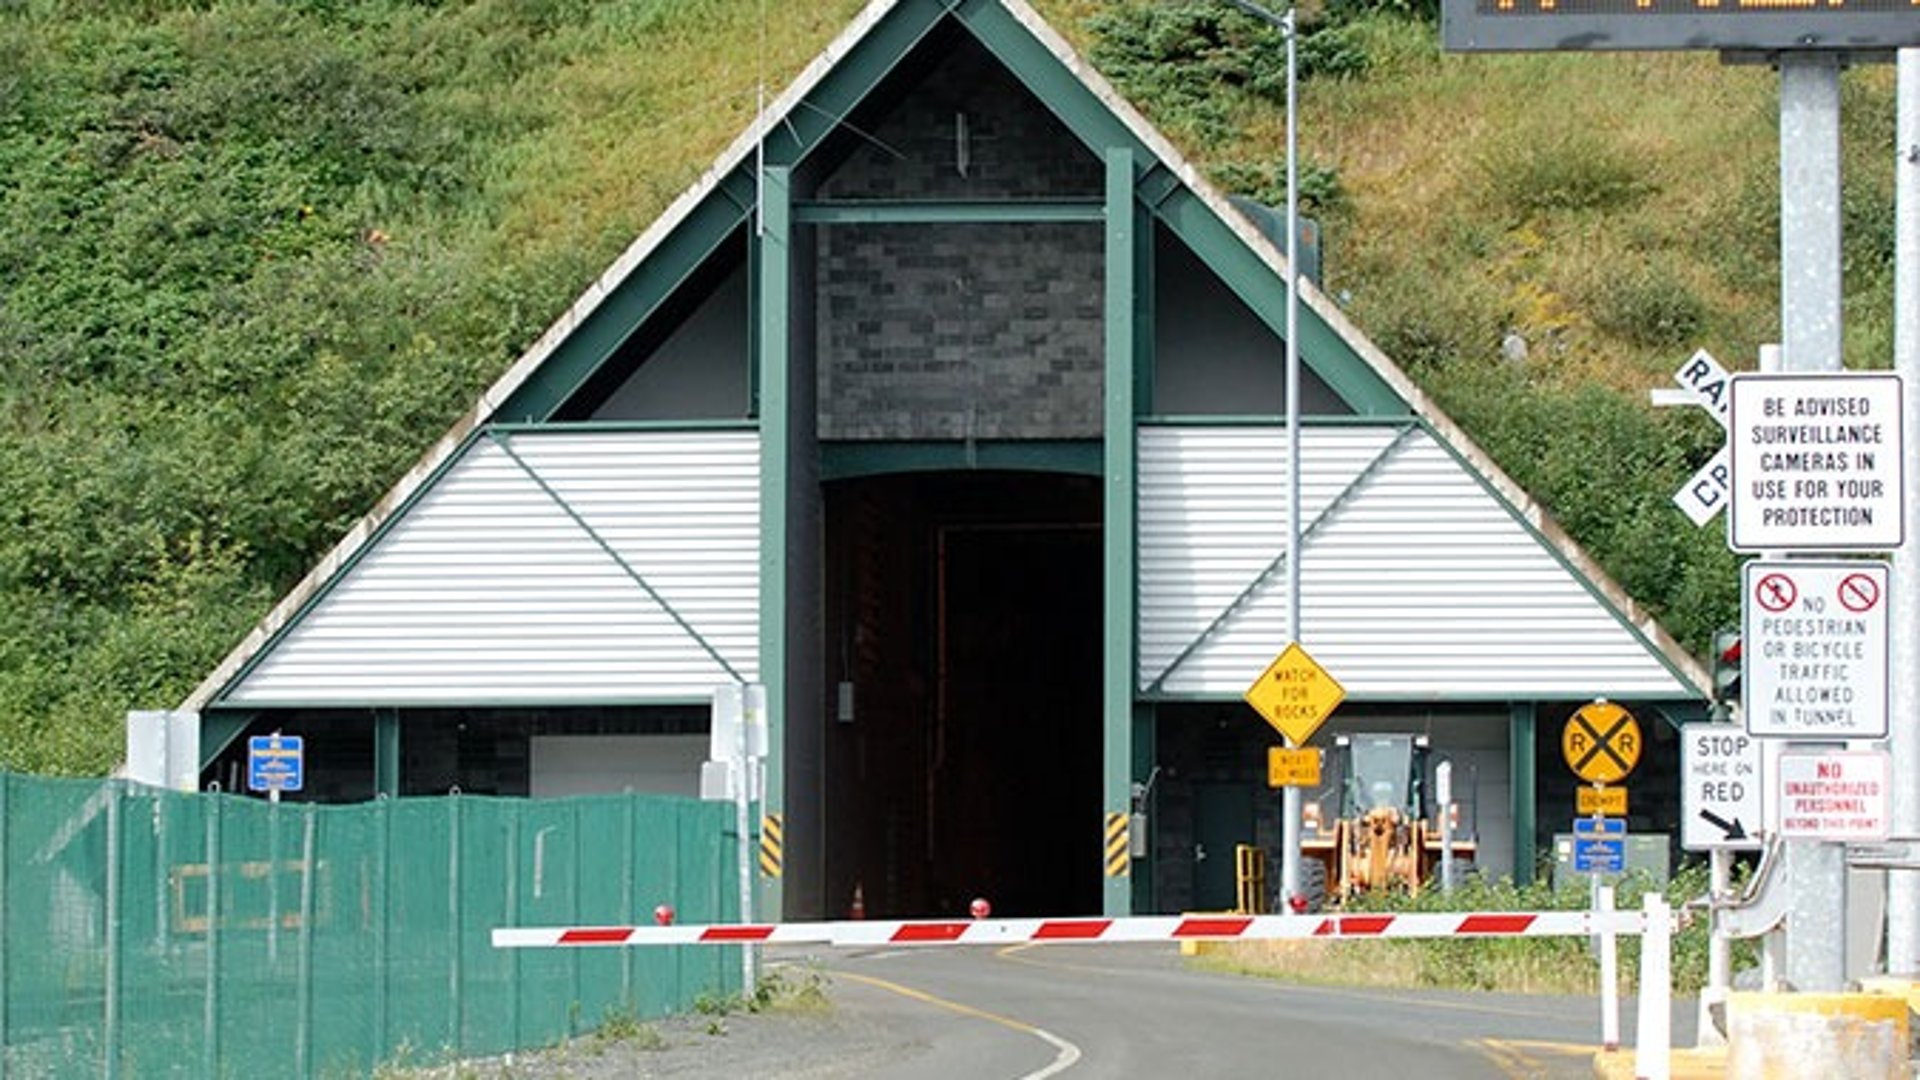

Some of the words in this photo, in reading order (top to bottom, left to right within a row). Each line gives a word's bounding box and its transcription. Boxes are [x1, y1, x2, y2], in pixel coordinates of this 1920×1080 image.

[1763, 397, 1785, 416] BE
[1794, 397, 1871, 416] ADVISED
[1751, 424, 1882, 444] SURVEILLANCE
[1760, 451, 1848, 471] CAMERAS
[1856, 451, 1875, 471] IN
[1752, 479, 1786, 500] USE
[1794, 479, 1828, 500] FOR
[1836, 479, 1884, 500] YOUR
[1762, 506, 1873, 526] PROTECTION
[1802, 596, 1826, 614] NO
[1762, 618, 1867, 636] PEDESTRIAN
[1763, 641, 1786, 659] OR
[1793, 641, 1864, 660] BICYCLE
[1274, 668, 1317, 682] WATCH
[1780, 663, 1849, 681] TRAFFIC
[1282, 686, 1309, 701] FOR
[1774, 686, 1854, 704] ALLOWED
[1274, 704, 1318, 720] ROCKS
[1770, 708, 1787, 724] IN
[1794, 707, 1855, 726] TUNNEL
[1570, 733, 1586, 752] R
[1619, 732, 1634, 752] R
[1697, 735, 1750, 757] STOP
[1692, 761, 1728, 776] HERE
[1734, 761, 1753, 776] ON
[1817, 762, 1842, 779] NO
[1702, 781, 1745, 802] RED
[1785, 781, 1879, 796] UNAUTHORIZED
[1794, 798, 1867, 813] PERSONNEL
